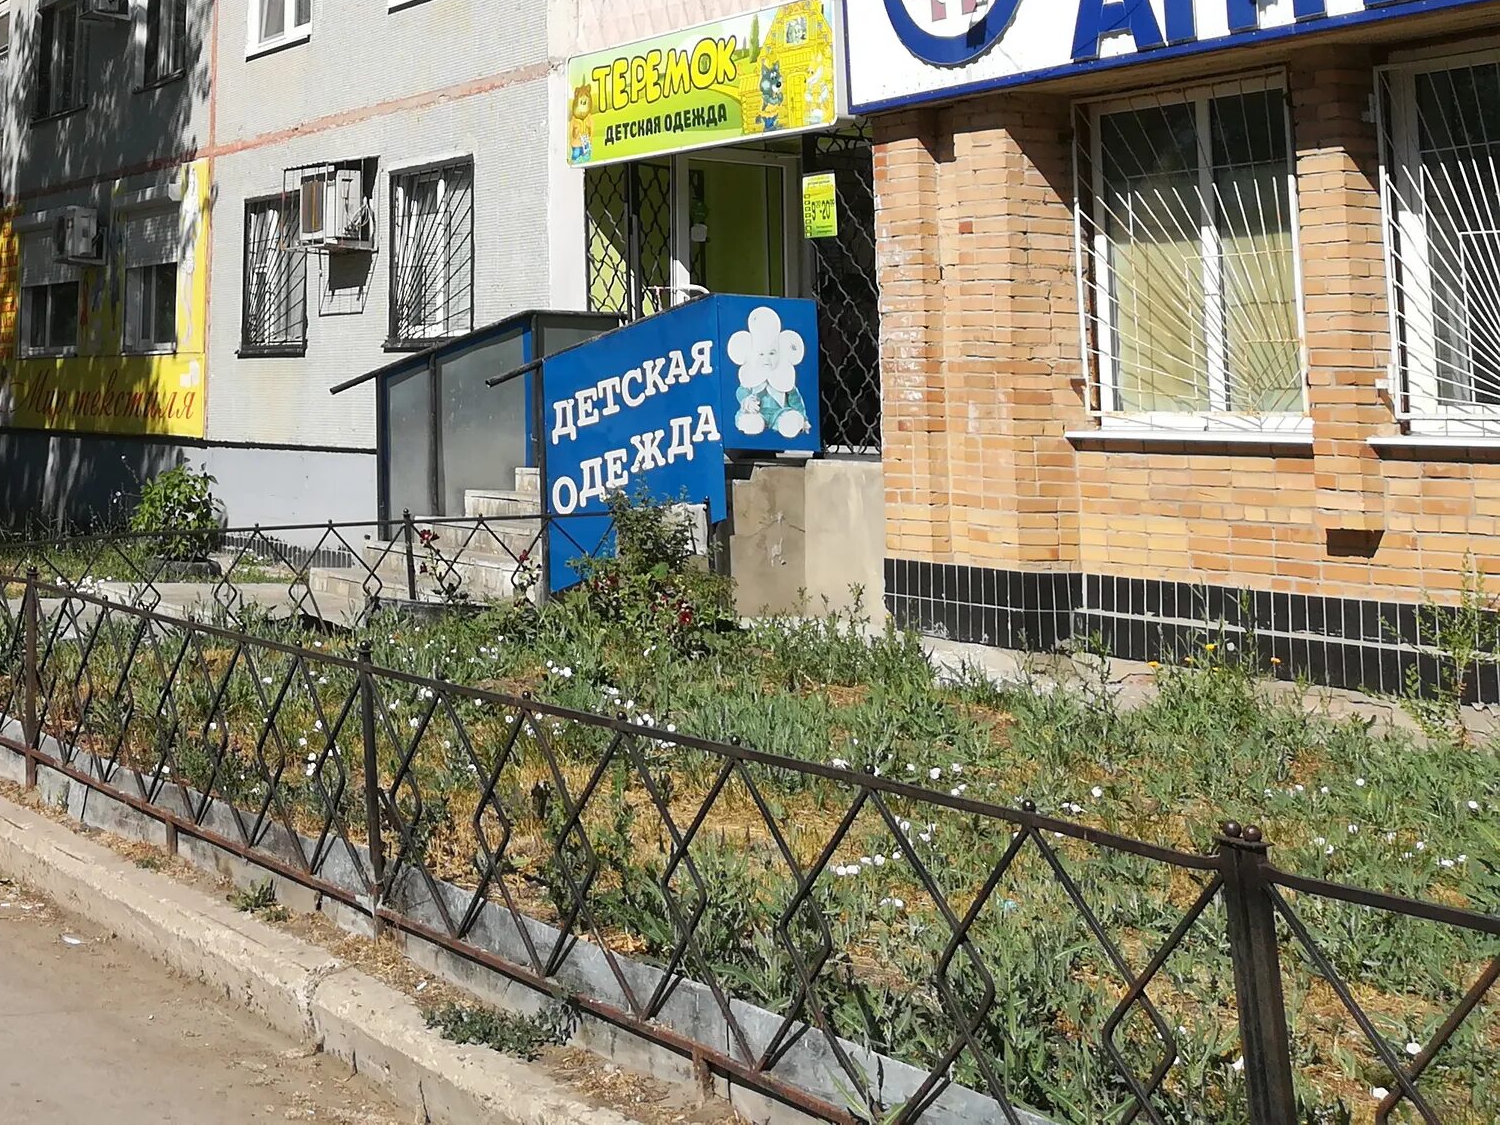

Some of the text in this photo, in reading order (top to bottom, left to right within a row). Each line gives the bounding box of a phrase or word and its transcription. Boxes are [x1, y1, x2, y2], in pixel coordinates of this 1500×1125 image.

[592, 35, 737, 114] ТЕРЕМОК
[604, 103, 728, 146] ДЕТСКАЯ ОДЕЖДА
[10, 368, 196, 426] Мир текстиля
[552, 340, 713, 445] ДЕТСКАЯ
[552, 405, 721, 515] ОДЕЖДА
